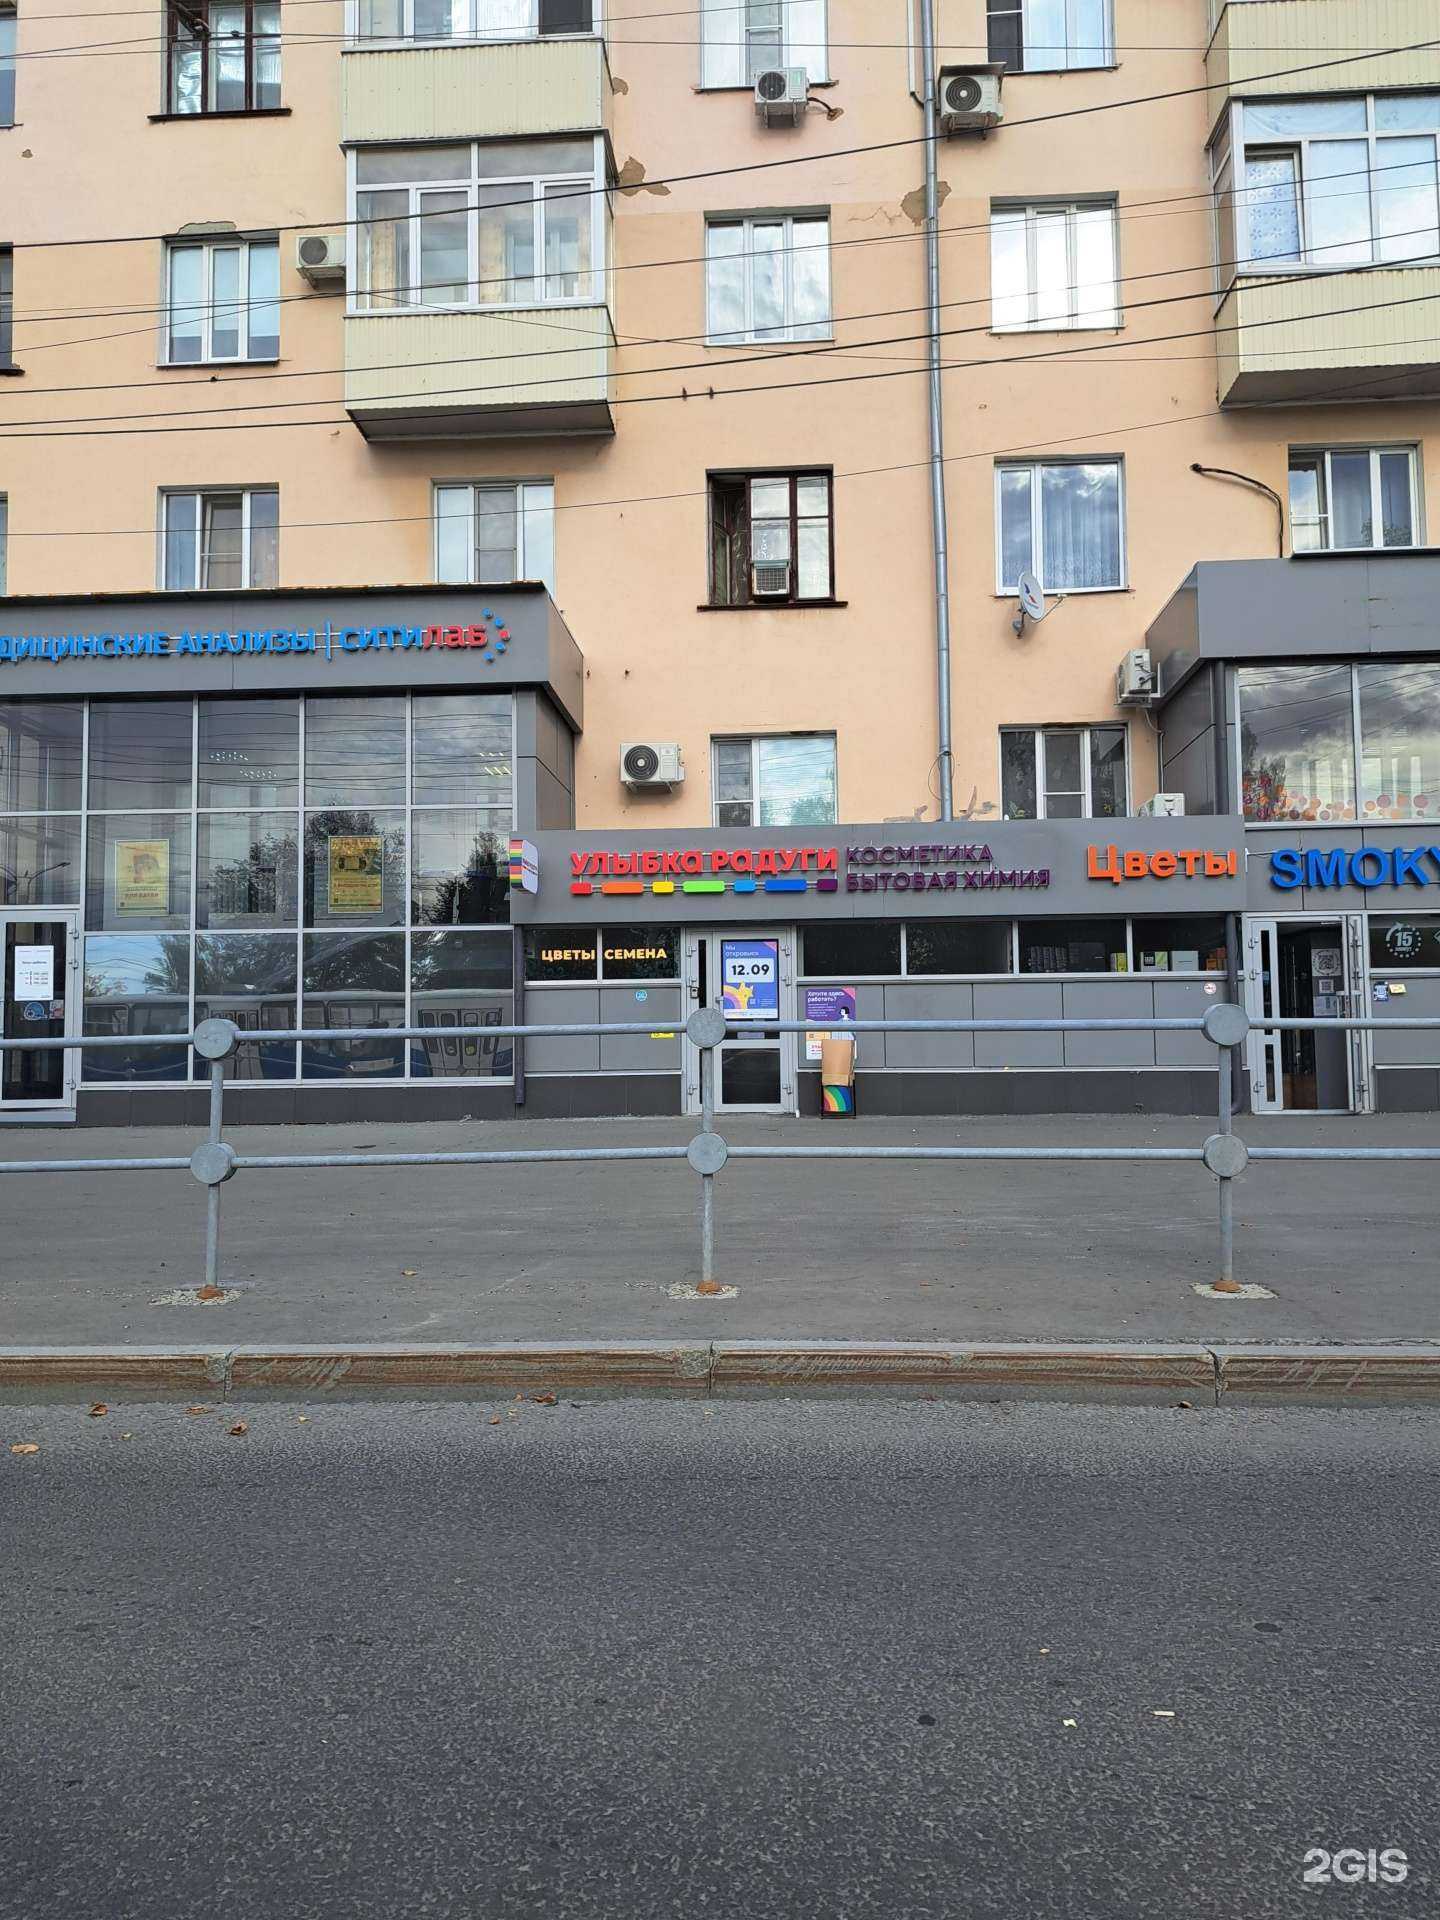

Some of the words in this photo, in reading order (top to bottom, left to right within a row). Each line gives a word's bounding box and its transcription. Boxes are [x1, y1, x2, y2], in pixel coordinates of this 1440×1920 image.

[177, 629, 316, 655] АНАЛИЗЫ
[846, 844, 993, 864] КОСМЕТИКА
[1087, 844, 1237, 885] Цветы
[847, 871, 959, 892] БЫТОВАЯ
[964, 869, 1050, 888] ХИМИЯ
[1395, 932, 1412, 946] 15
[541, 949, 596, 962] ЦВЕТЫ
[603, 948, 668, 960] СЕМЕНА
[732, 964, 770, 976] 12.09
